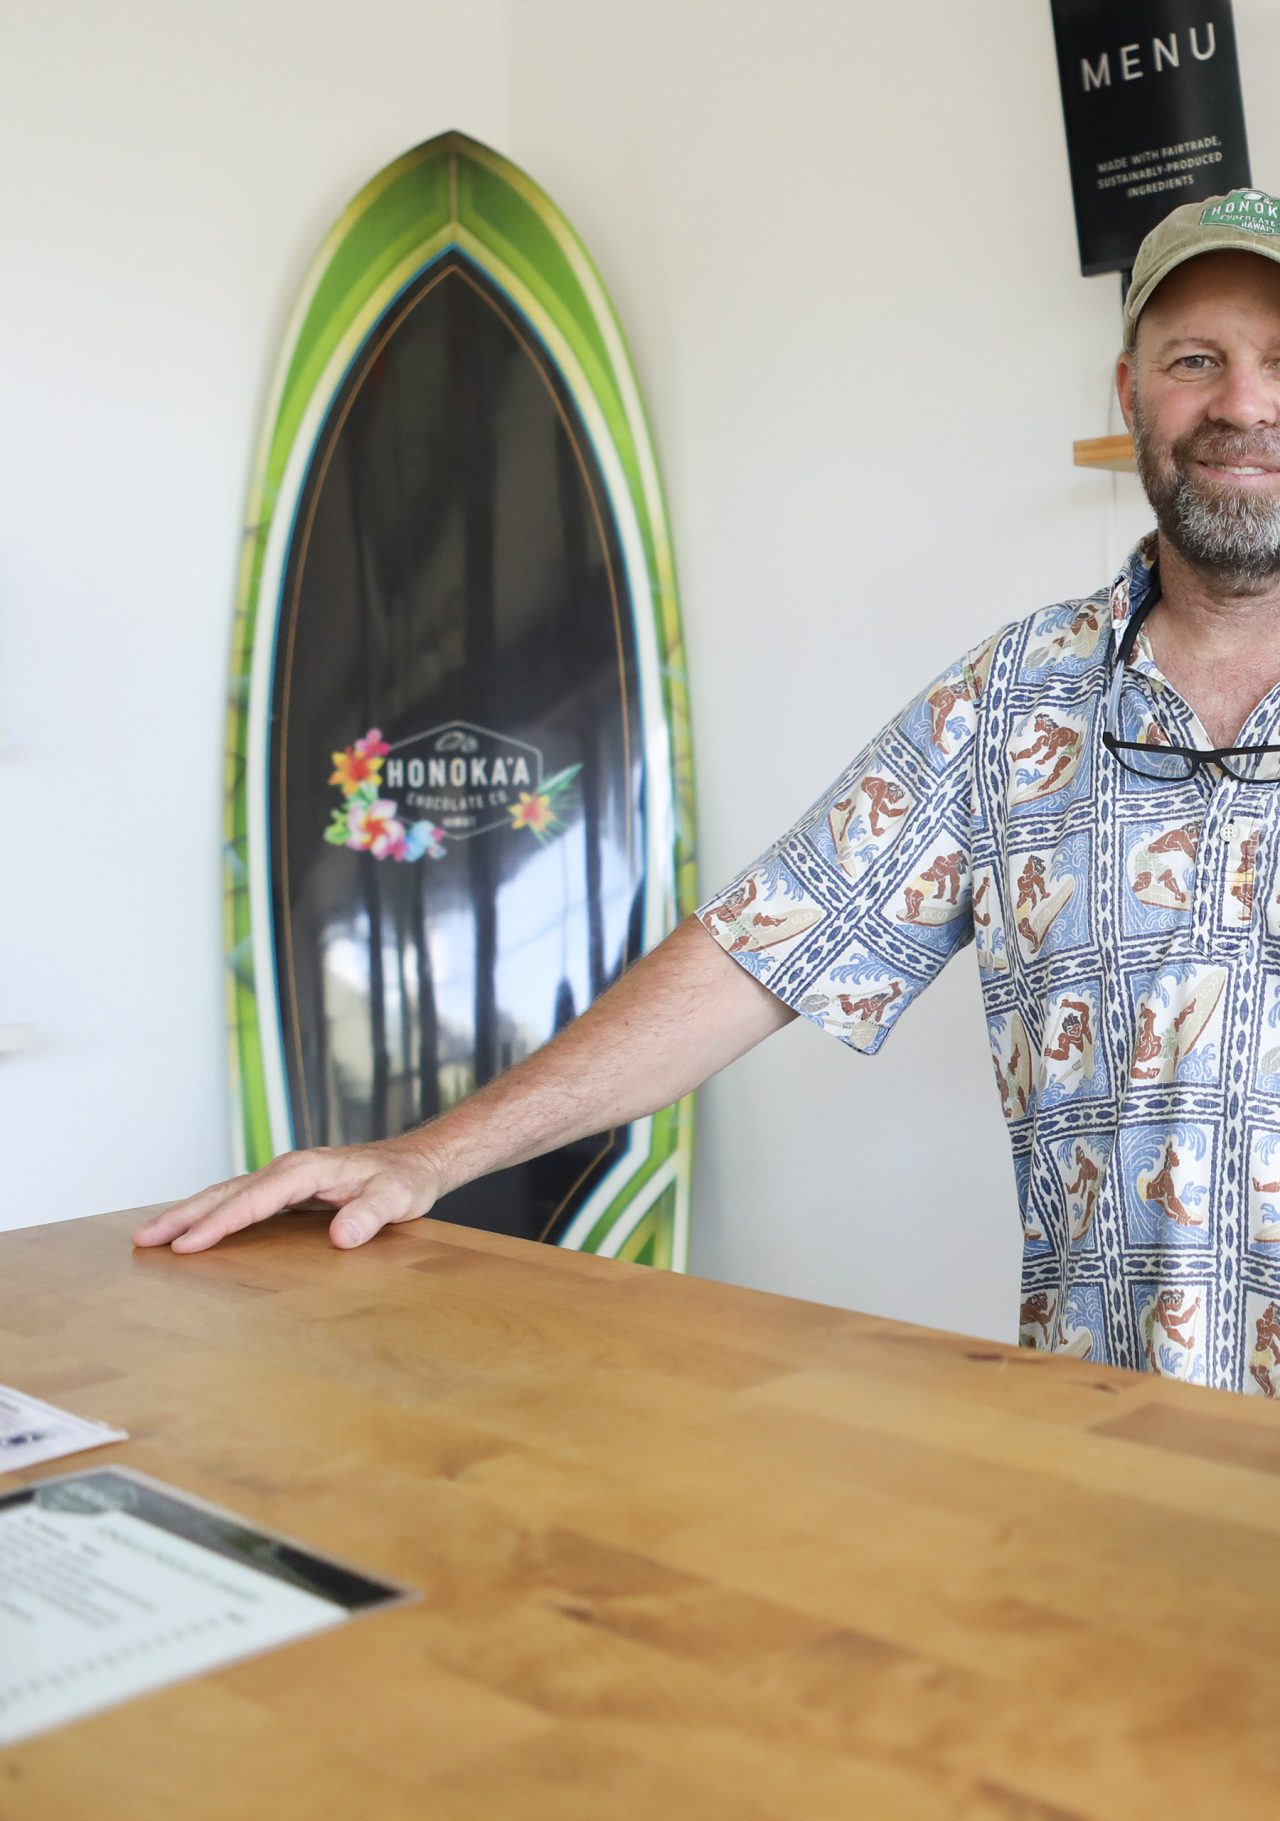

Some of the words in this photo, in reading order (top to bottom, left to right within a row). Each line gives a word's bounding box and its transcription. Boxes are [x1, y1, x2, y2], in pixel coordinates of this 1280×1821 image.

[1081, 22, 1216, 92] MENU
[1097, 157, 1128, 173] MADE
[1130, 149, 1160, 164] WITH
[1097, 151, 1223, 189] SUSTAINABLY-PRODUCED
[1127, 174, 1195, 198] INGREDIENTS
[386, 755, 531, 788] HONOKA'A
